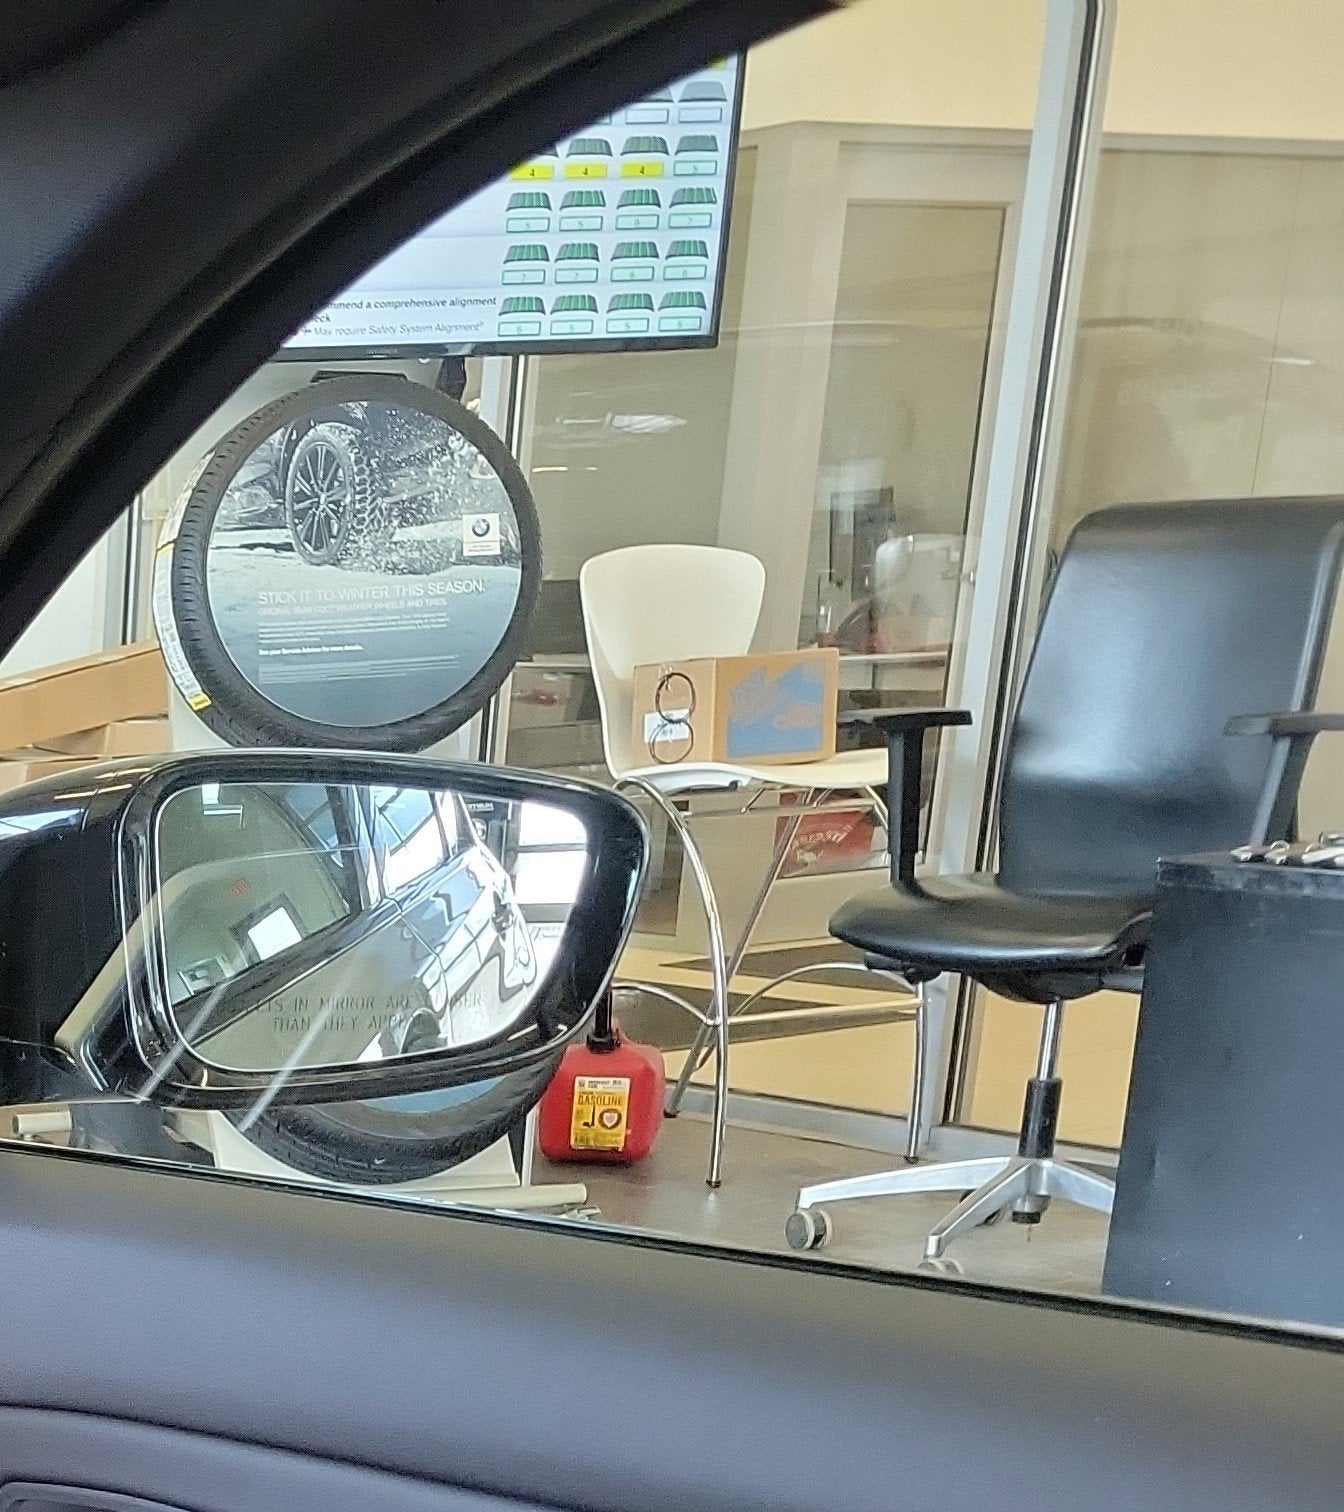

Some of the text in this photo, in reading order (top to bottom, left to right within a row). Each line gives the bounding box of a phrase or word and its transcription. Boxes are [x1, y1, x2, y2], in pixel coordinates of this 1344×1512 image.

[373, 299, 447, 310] comprehensive
[449, 297, 497, 308] alignment
[399, 324, 433, 335] System
[258, 579, 486, 605] STICK IT TO WINTER THIS SEASON.
[319, 996, 375, 1011] MIRROR
[577, 1095, 624, 1106] GASOLINE
